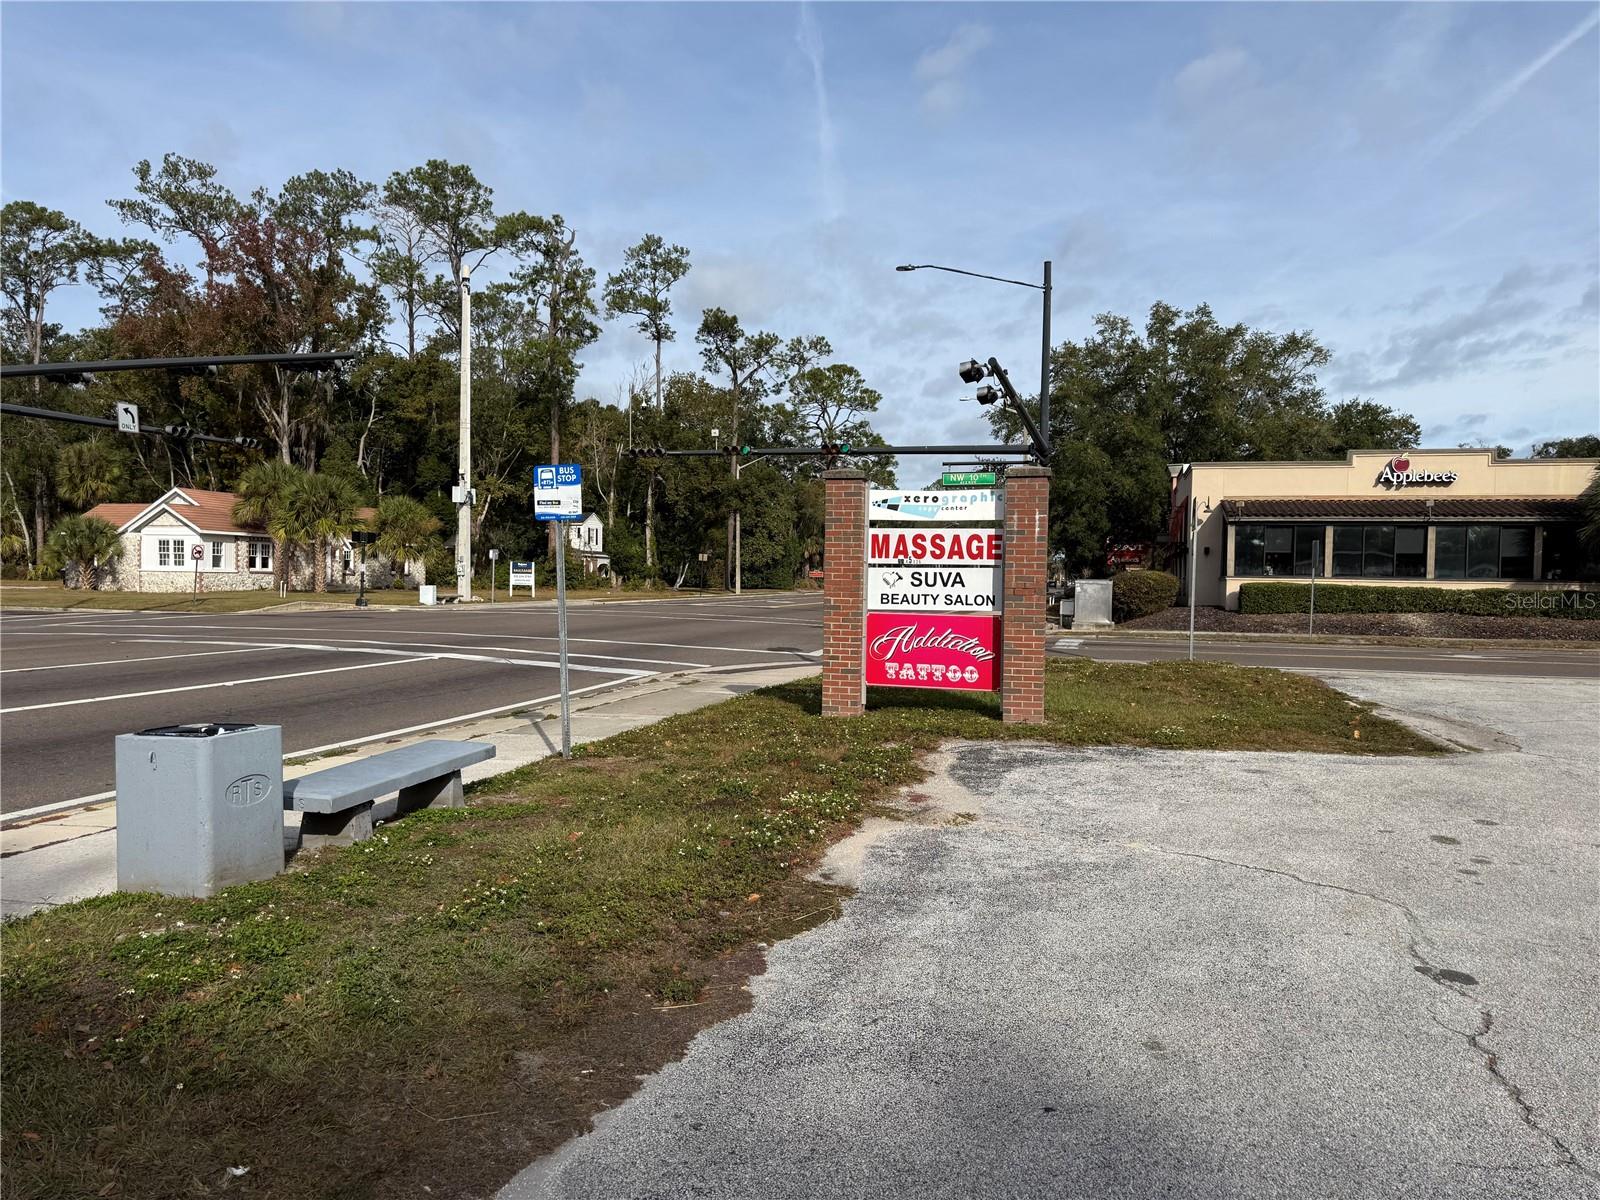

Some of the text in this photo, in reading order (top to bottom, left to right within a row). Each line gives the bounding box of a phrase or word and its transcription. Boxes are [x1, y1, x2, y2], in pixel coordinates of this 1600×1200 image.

[557, 474, 577, 482] STOP
[559, 466, 574, 474] BUS
[950, 474, 964, 482] NW
[1380, 467, 1458, 485] Applebee's
[903, 490, 1003, 506] xerographic
[871, 533, 1003, 561] MASSAGE
[910, 571, 966, 588] SUVA
[880, 593, 996, 607] BEAUTY SALON
[870, 622, 995, 662] Addiction
[885, 662, 979, 683] TATTOO
[232, 778, 262, 804] RTS
